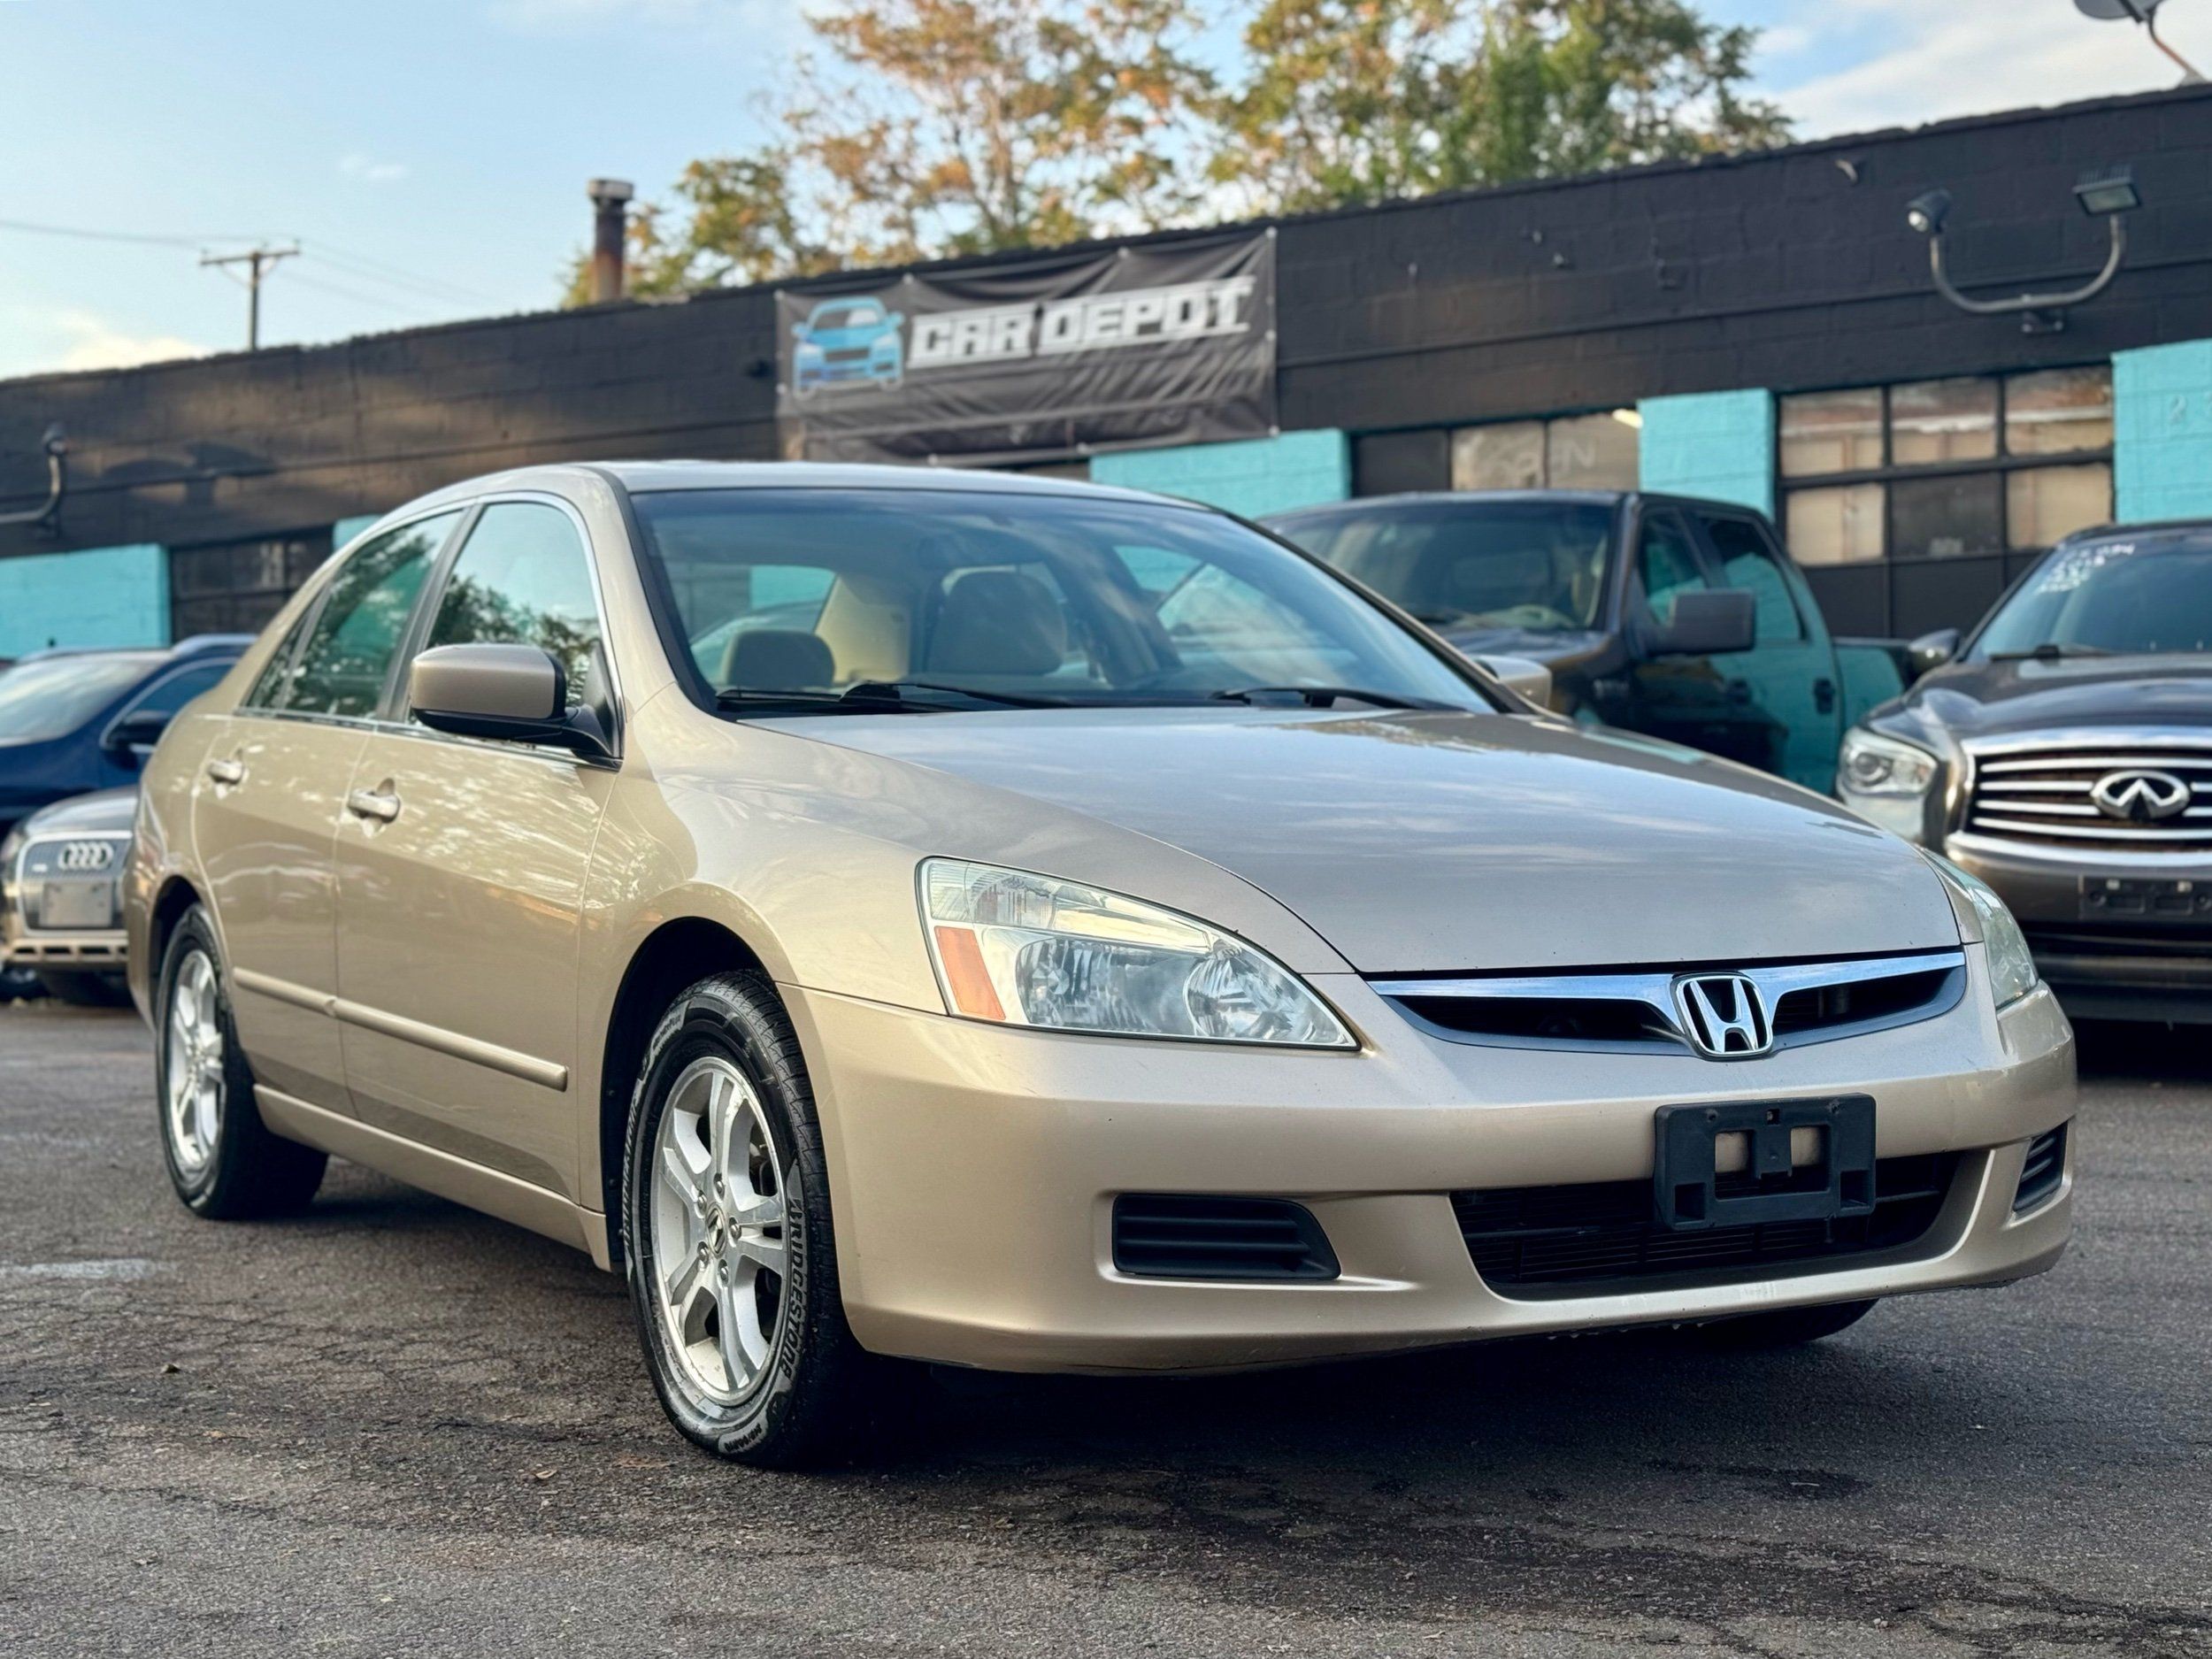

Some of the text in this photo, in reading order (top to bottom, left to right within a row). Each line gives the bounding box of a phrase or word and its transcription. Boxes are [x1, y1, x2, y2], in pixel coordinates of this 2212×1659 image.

[908, 276, 1256, 369] CAR DEPOT
[780, 1198, 803, 1379] BRIDGESTONE
